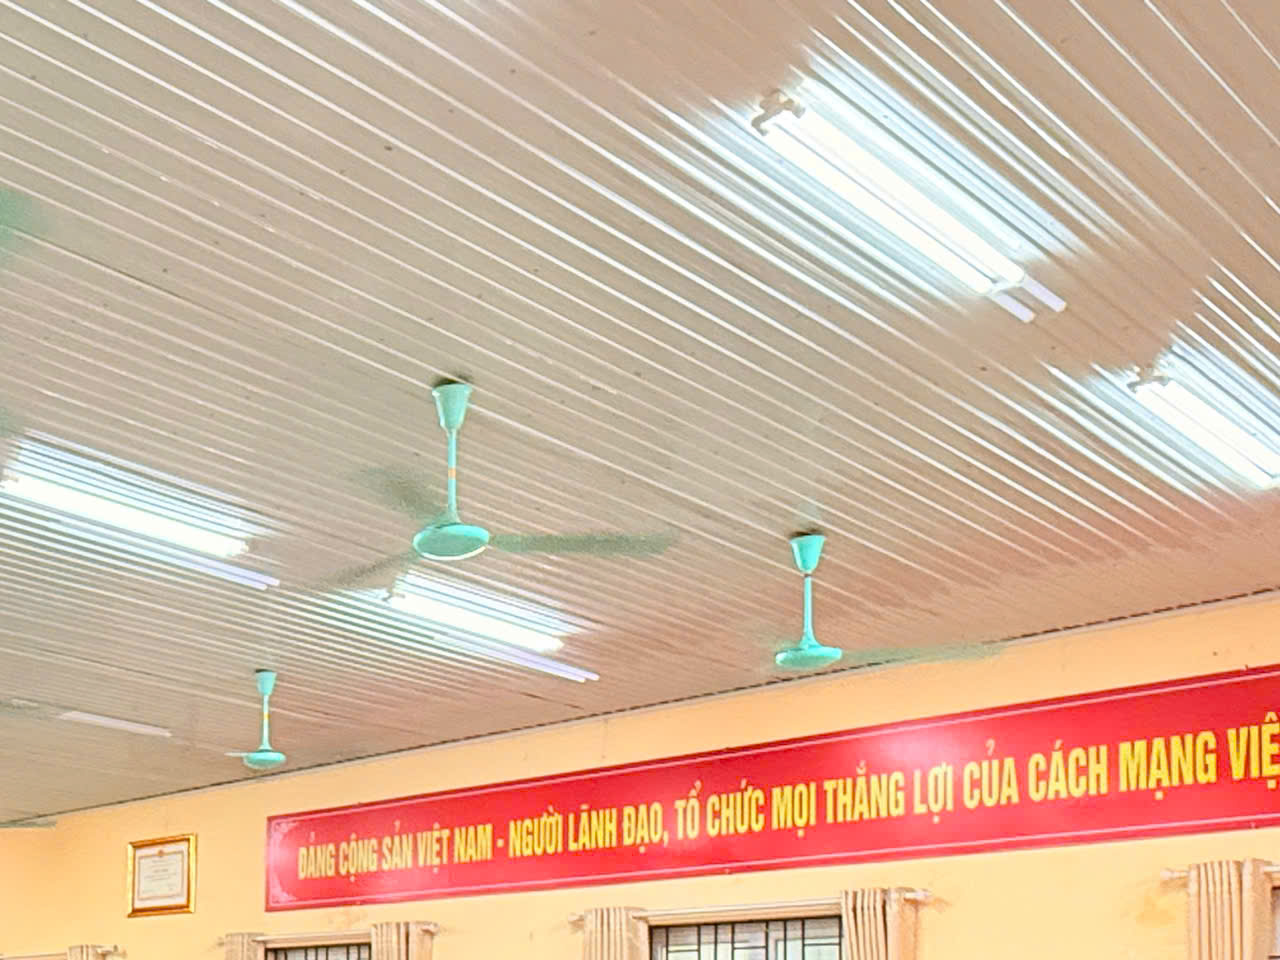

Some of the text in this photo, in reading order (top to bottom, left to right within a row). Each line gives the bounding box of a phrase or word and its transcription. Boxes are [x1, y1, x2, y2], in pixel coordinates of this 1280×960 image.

[297, 831, 336, 880] ĐẢNG
[338, 832, 378, 883] CỘNG
[381, 820, 414, 871] SẢN
[416, 822, 450, 874] VIỆT
[452, 823, 494, 864] NAM
[508, 804, 563, 859] NGƯỜI
[567, 803, 618, 852] LÃNH
[622, 801, 669, 854] ĐẠO,
[674, 780, 703, 840] TỔ
[706, 778, 765, 837] CHỨC
[771, 782, 817, 838] MỌI
[824, 761, 906, 823] THẮNG
[913, 761, 954, 824] LỢI
[963, 739, 1020, 809] CỦA
[1027, 739, 1109, 802] CÁCH
[1118, 729, 1218, 801] MẠNG
